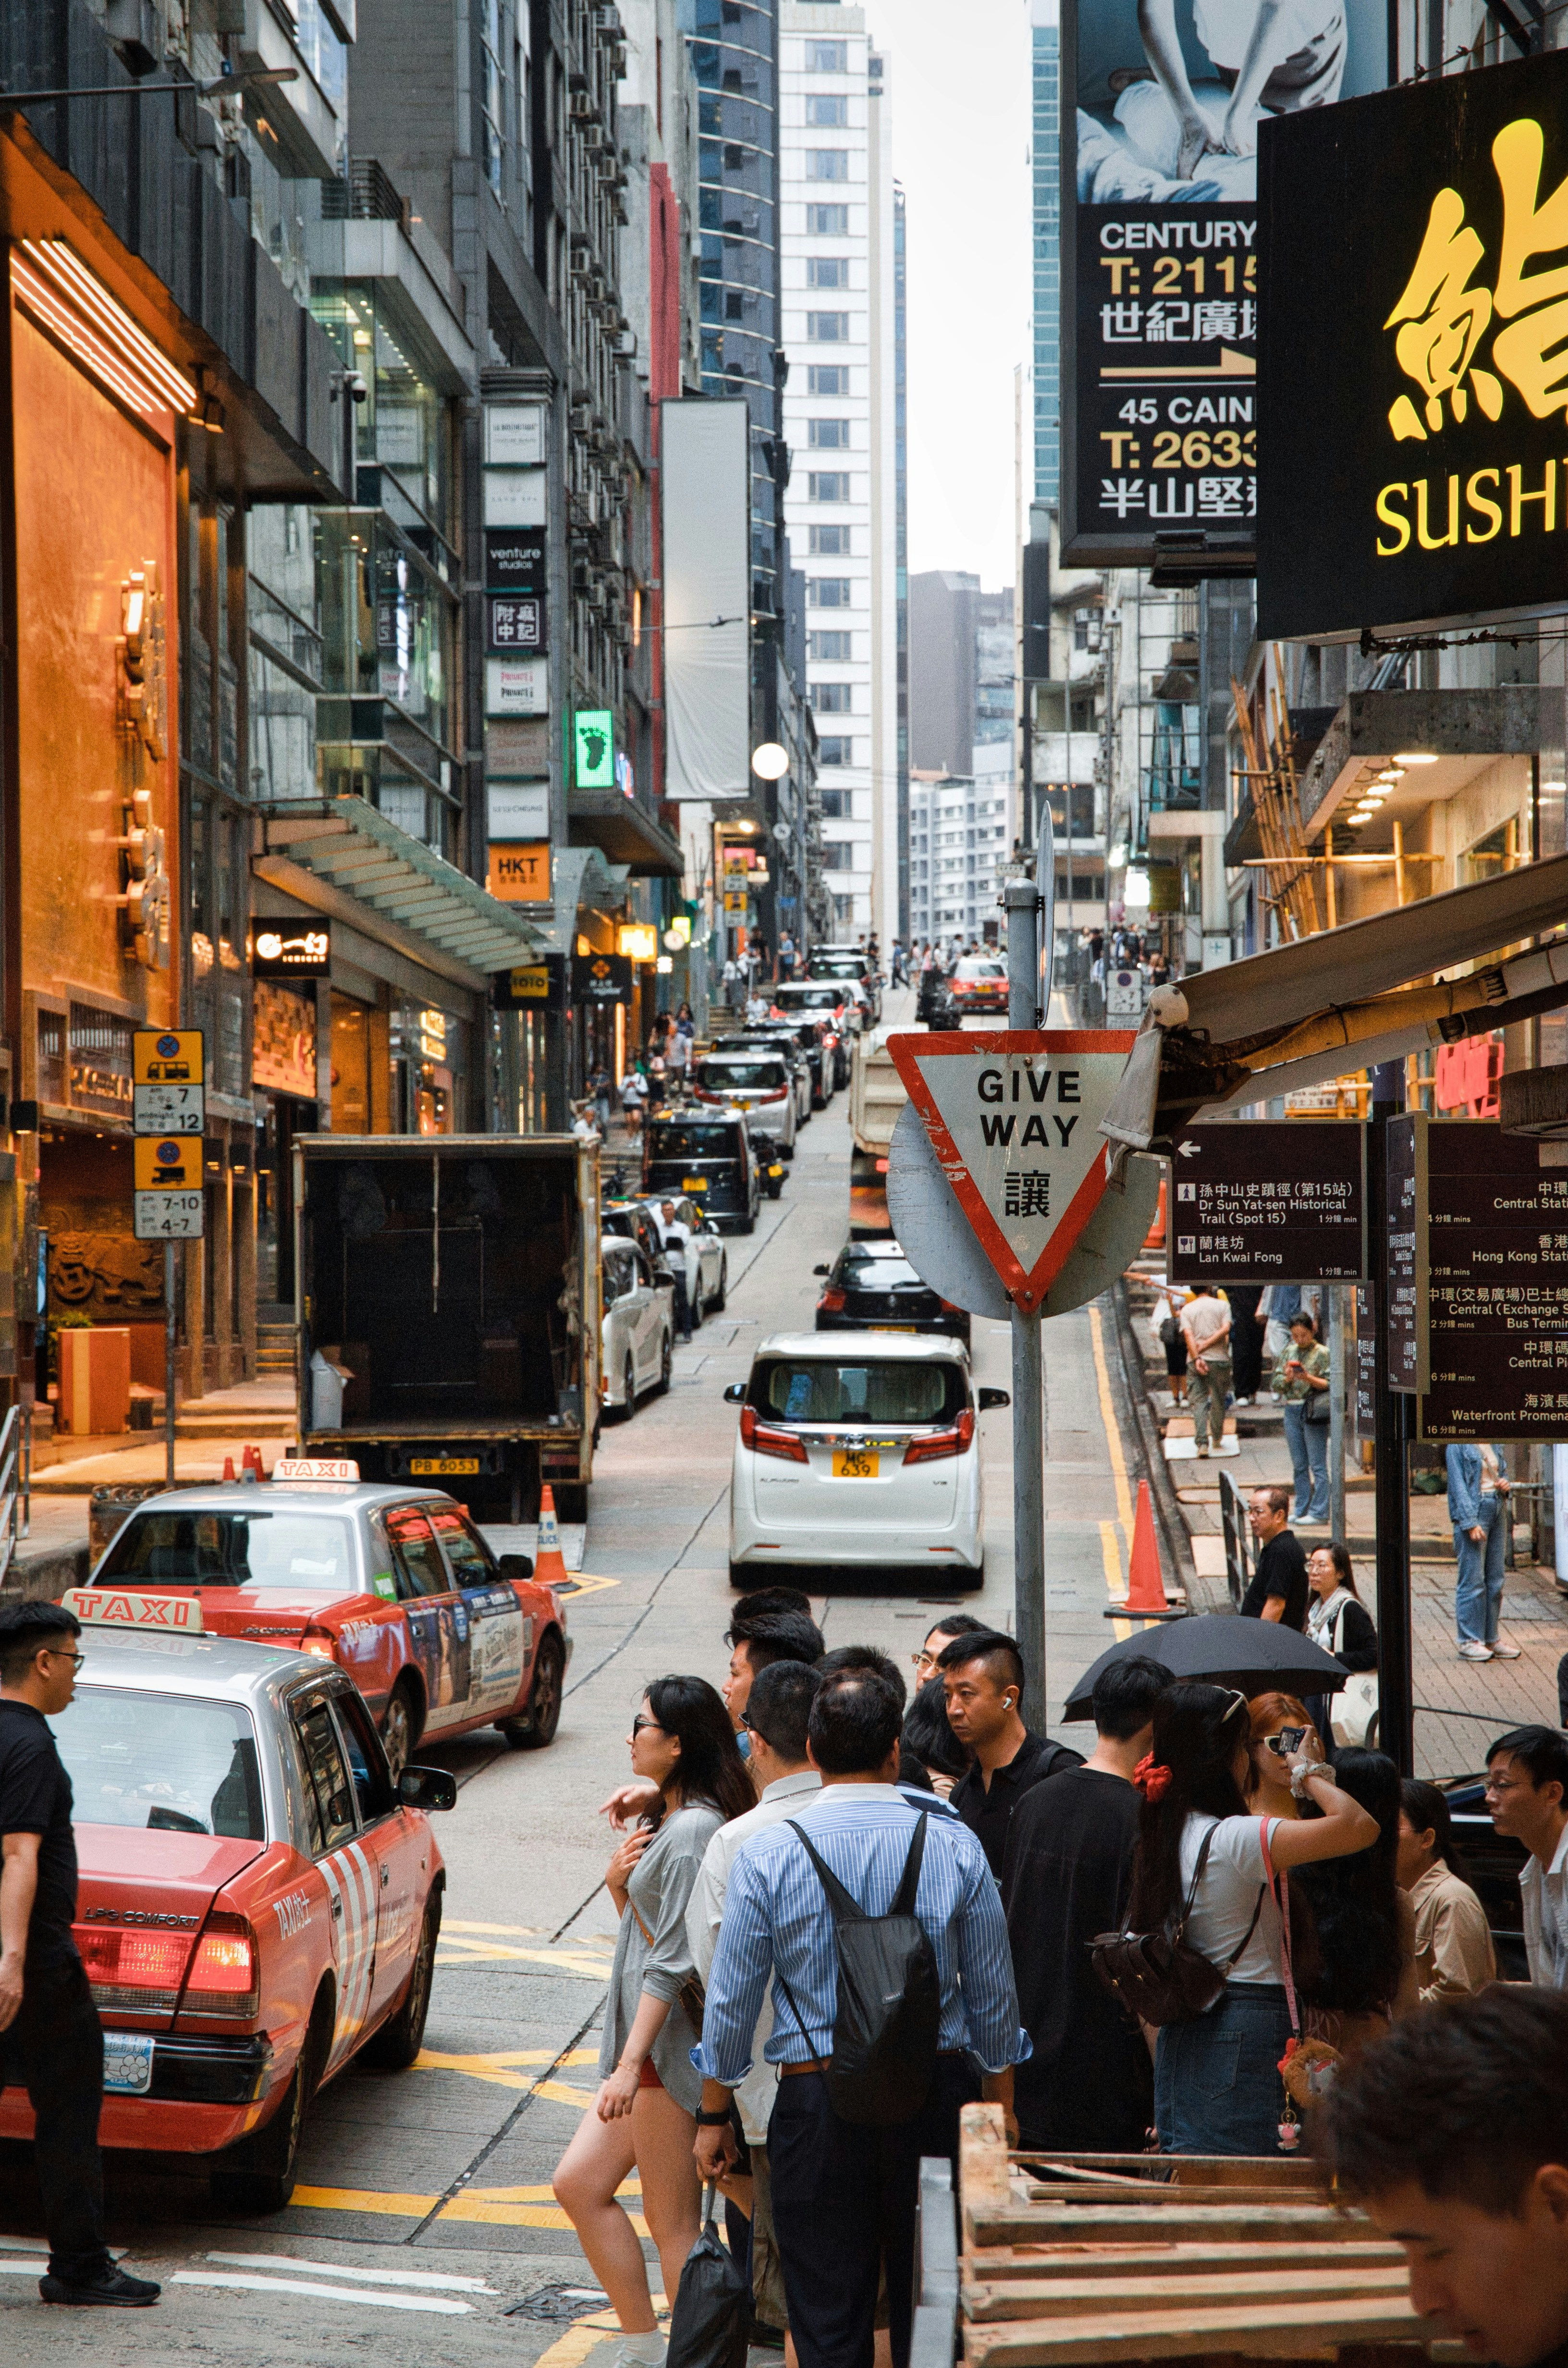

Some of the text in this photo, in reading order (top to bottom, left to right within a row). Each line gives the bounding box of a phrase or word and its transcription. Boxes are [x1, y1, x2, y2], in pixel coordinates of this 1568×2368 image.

[1100, 221, 1256, 249] CENTURY
[1100, 257, 1140, 294] T:
[1119, 396, 1252, 424] 45 CAIN
[1100, 432, 1140, 468] T:
[1100, 477, 1256, 518] 半山堅
[1376, 459, 1568, 555] SUSH
[490, 547, 541, 559] venture
[498, 560, 533, 569] studios
[499, 858, 538, 873] HKT
[978, 1070, 1081, 1103] GIVE
[178, 1089, 188, 1102] 7
[179, 1114, 199, 1129] 12
[980, 1114, 1079, 1147] WAY
[1004, 1170, 1051, 1218] 讓
[162, 1196, 198, 1209] 7-10
[1200, 1199, 1347, 1210] Dr Sun Yat-sen Historical
[1494, 1198, 1538, 1208] Central
[161, 1219, 189, 1231] 4-7
[1200, 1212, 1286, 1225] Trail (Spot 15)
[1319, 1215, 1323, 1223] 1
[1199, 1236, 1244, 1250] 蘭桂坊
[1539, 1234, 1568, 1248] 香港
[1200, 1252, 1283, 1264] Lan Kwai Fong
[1472, 1251, 1504, 1263] Hong
[1508, 1251, 1538, 1263] Kong
[1449, 1304, 1493, 1314] Central
[1496, 1304, 1559, 1316] (Exchange
[1507, 1318, 1529, 1328] Bus
[1524, 1341, 1568, 1355] 中環碼
[1509, 1357, 1568, 1368] Central Pi
[1452, 1410, 1516, 1420] Waterfront
[1427, 1426, 1437, 1434] 16
[281, 1462, 348, 1477] TAXI
[415, 1460, 475, 1471] PB 6053
[841, 1464, 871, 1477] 639
[73, 1593, 190, 1627] TAXI
[85, 1907, 200, 1927] LPG COMFORT
[273, 1888, 312, 1940] TAXI 的士
